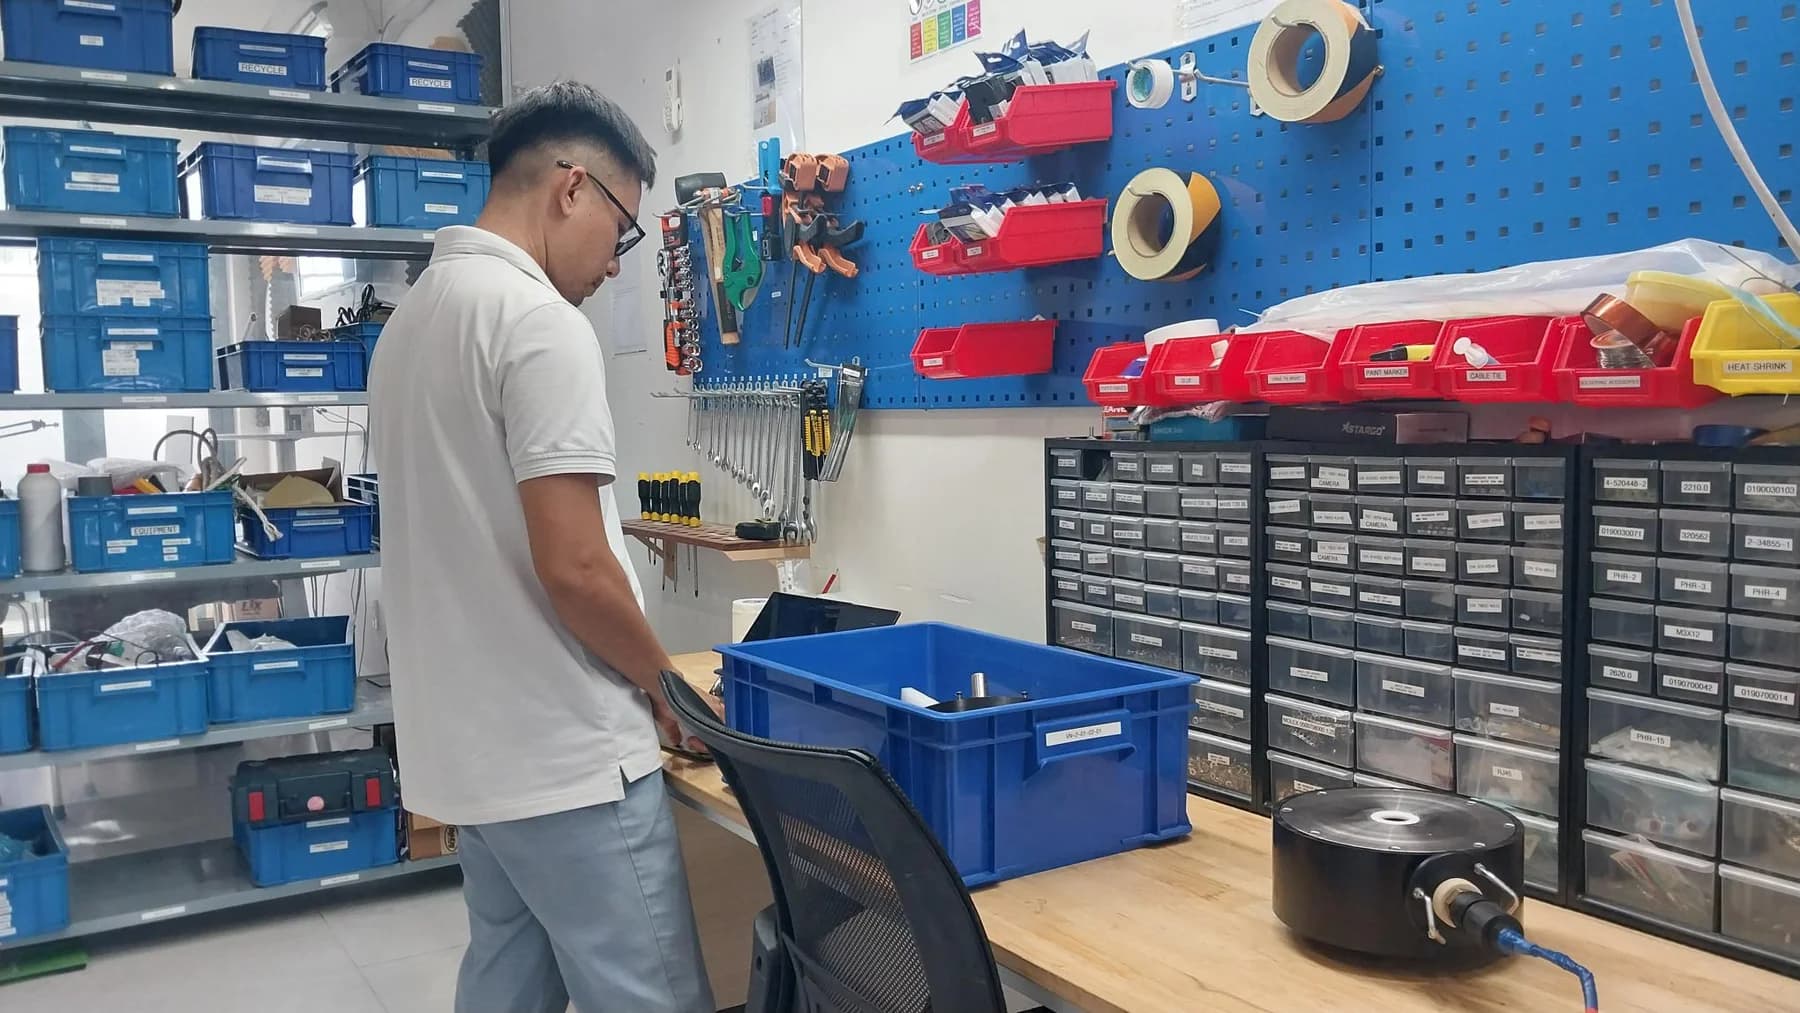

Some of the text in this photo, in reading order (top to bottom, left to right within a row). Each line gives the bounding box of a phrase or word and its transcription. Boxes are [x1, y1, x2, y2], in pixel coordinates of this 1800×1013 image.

[241, 63, 285, 74] RECYCLE
[411, 78, 449, 88] RECYCLE
[1727, 362, 1787, 371] HEAT SHRINK
[1365, 367, 1408, 377] PAINT MARKER
[1470, 372, 1503, 380] CABLE TIE
[134, 526, 177, 535] EQUIPMENT
